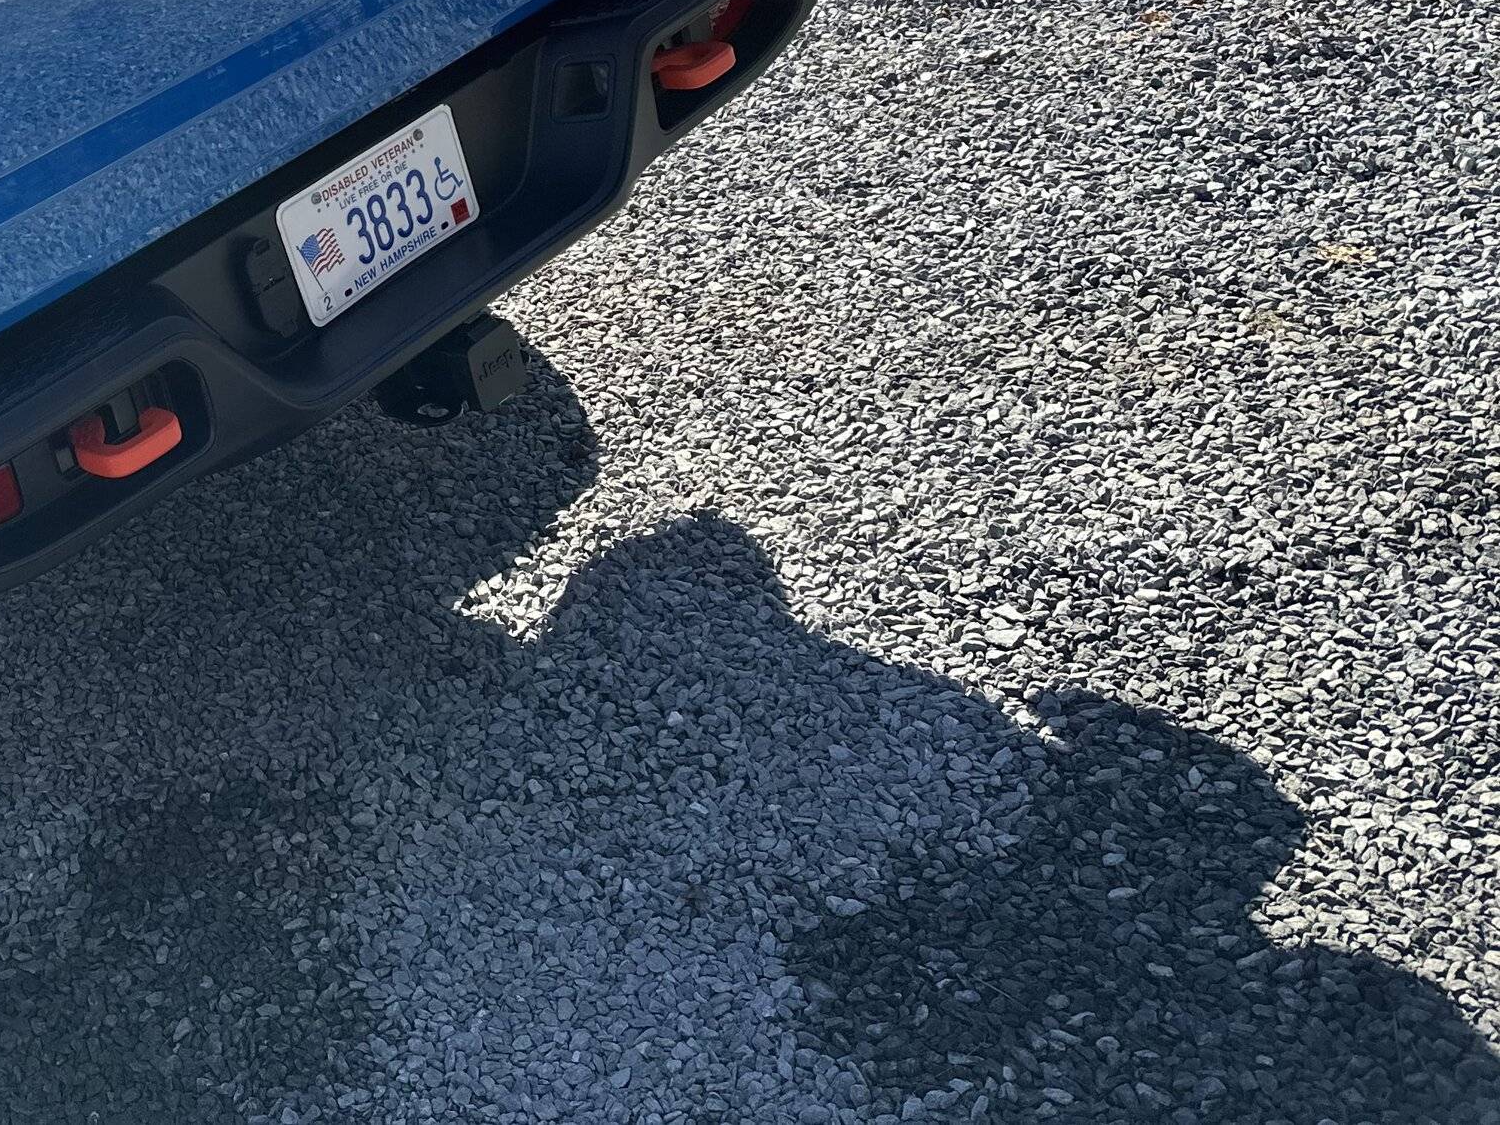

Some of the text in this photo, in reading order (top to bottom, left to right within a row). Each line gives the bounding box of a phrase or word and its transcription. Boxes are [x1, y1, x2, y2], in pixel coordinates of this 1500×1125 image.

[322, 136, 414, 202] DISABLED VETERAN
[338, 161, 408, 210] LIVE FREE OR DIE
[346, 168, 433, 265] 3833
[354, 225, 437, 291] NEW HAMPSHIRE
[323, 295, 333, 311] 2
